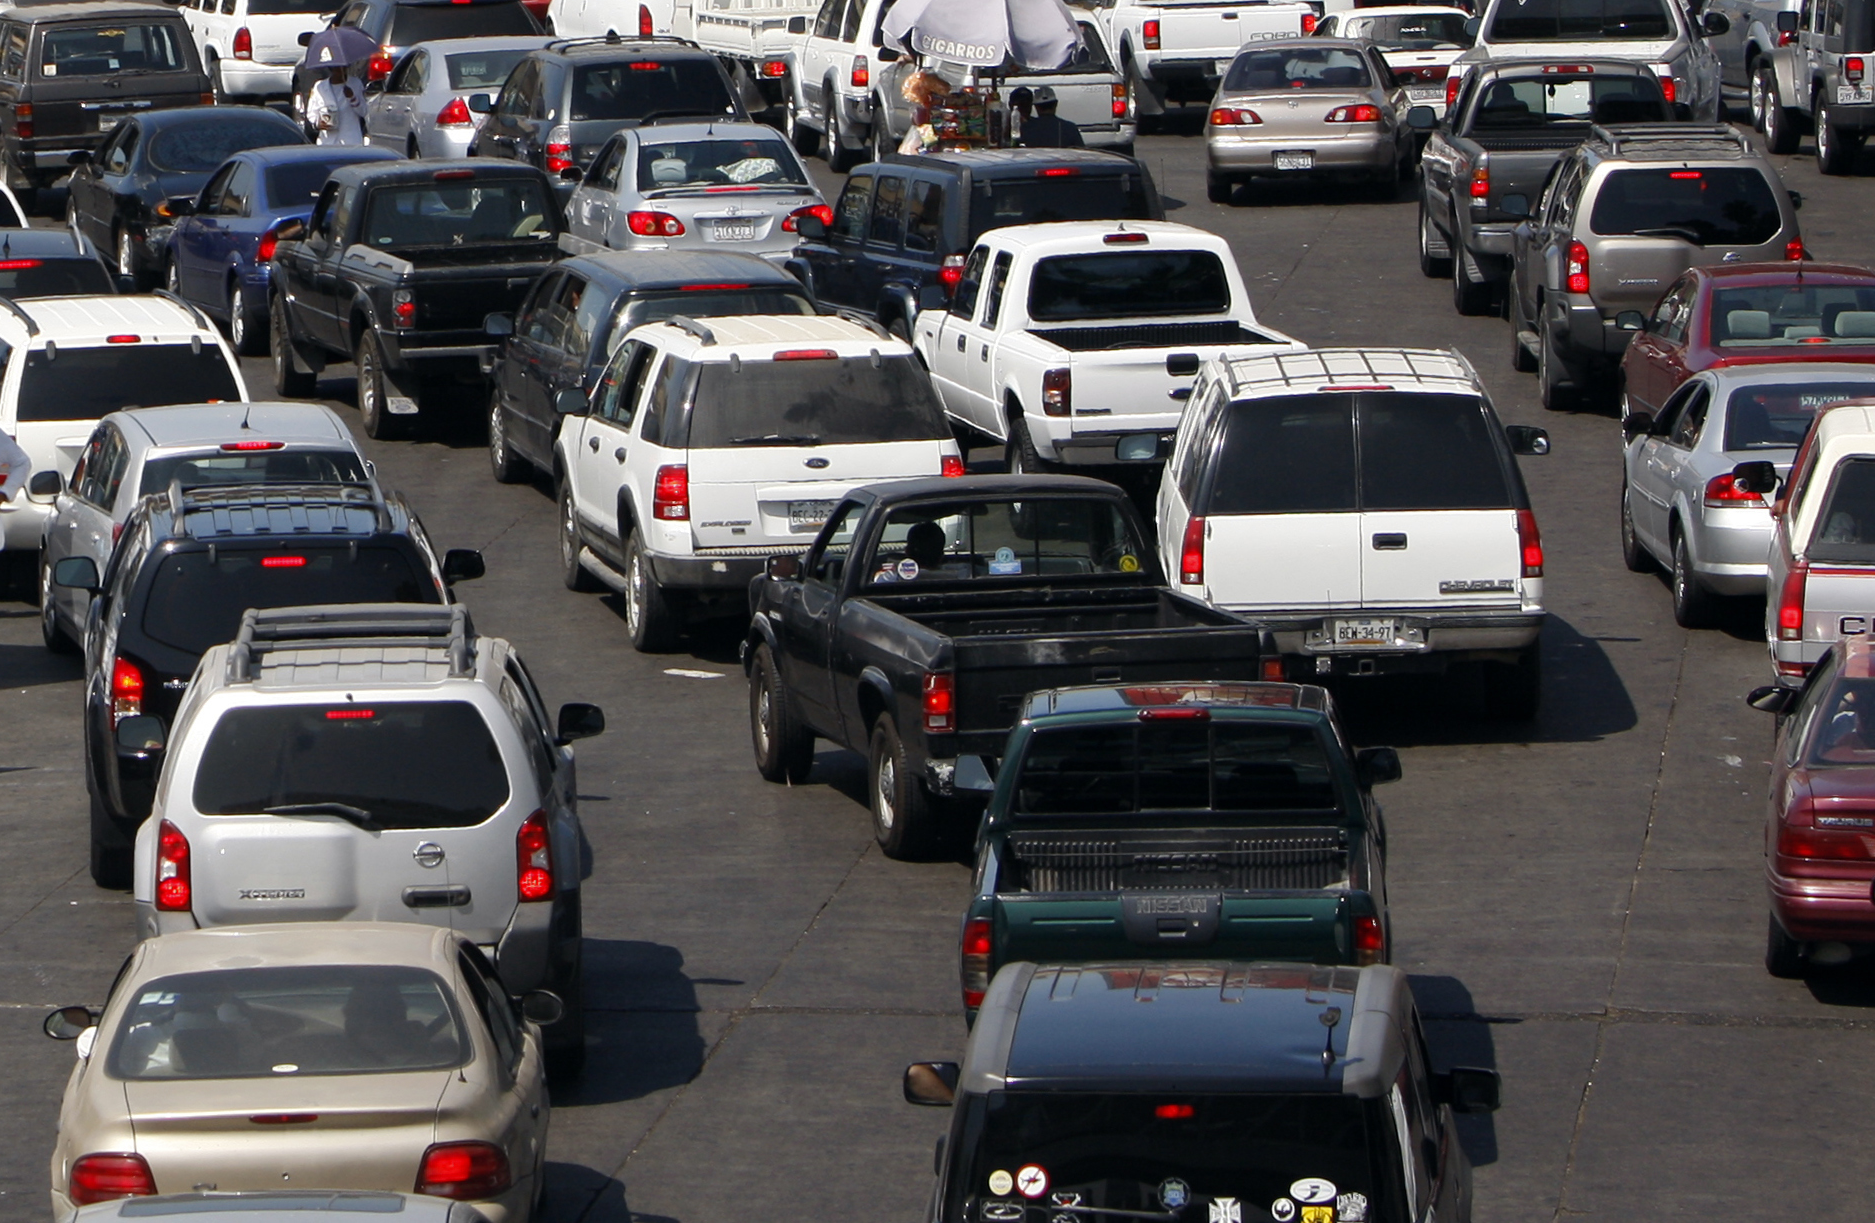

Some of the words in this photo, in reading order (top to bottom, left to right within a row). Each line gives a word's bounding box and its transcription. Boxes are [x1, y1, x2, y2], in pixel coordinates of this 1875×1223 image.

[922, 34, 997, 60] CIGARROS
[1438, 579, 1515, 594] CHEVROLET
[1136, 897, 1208, 915] NISSAN
